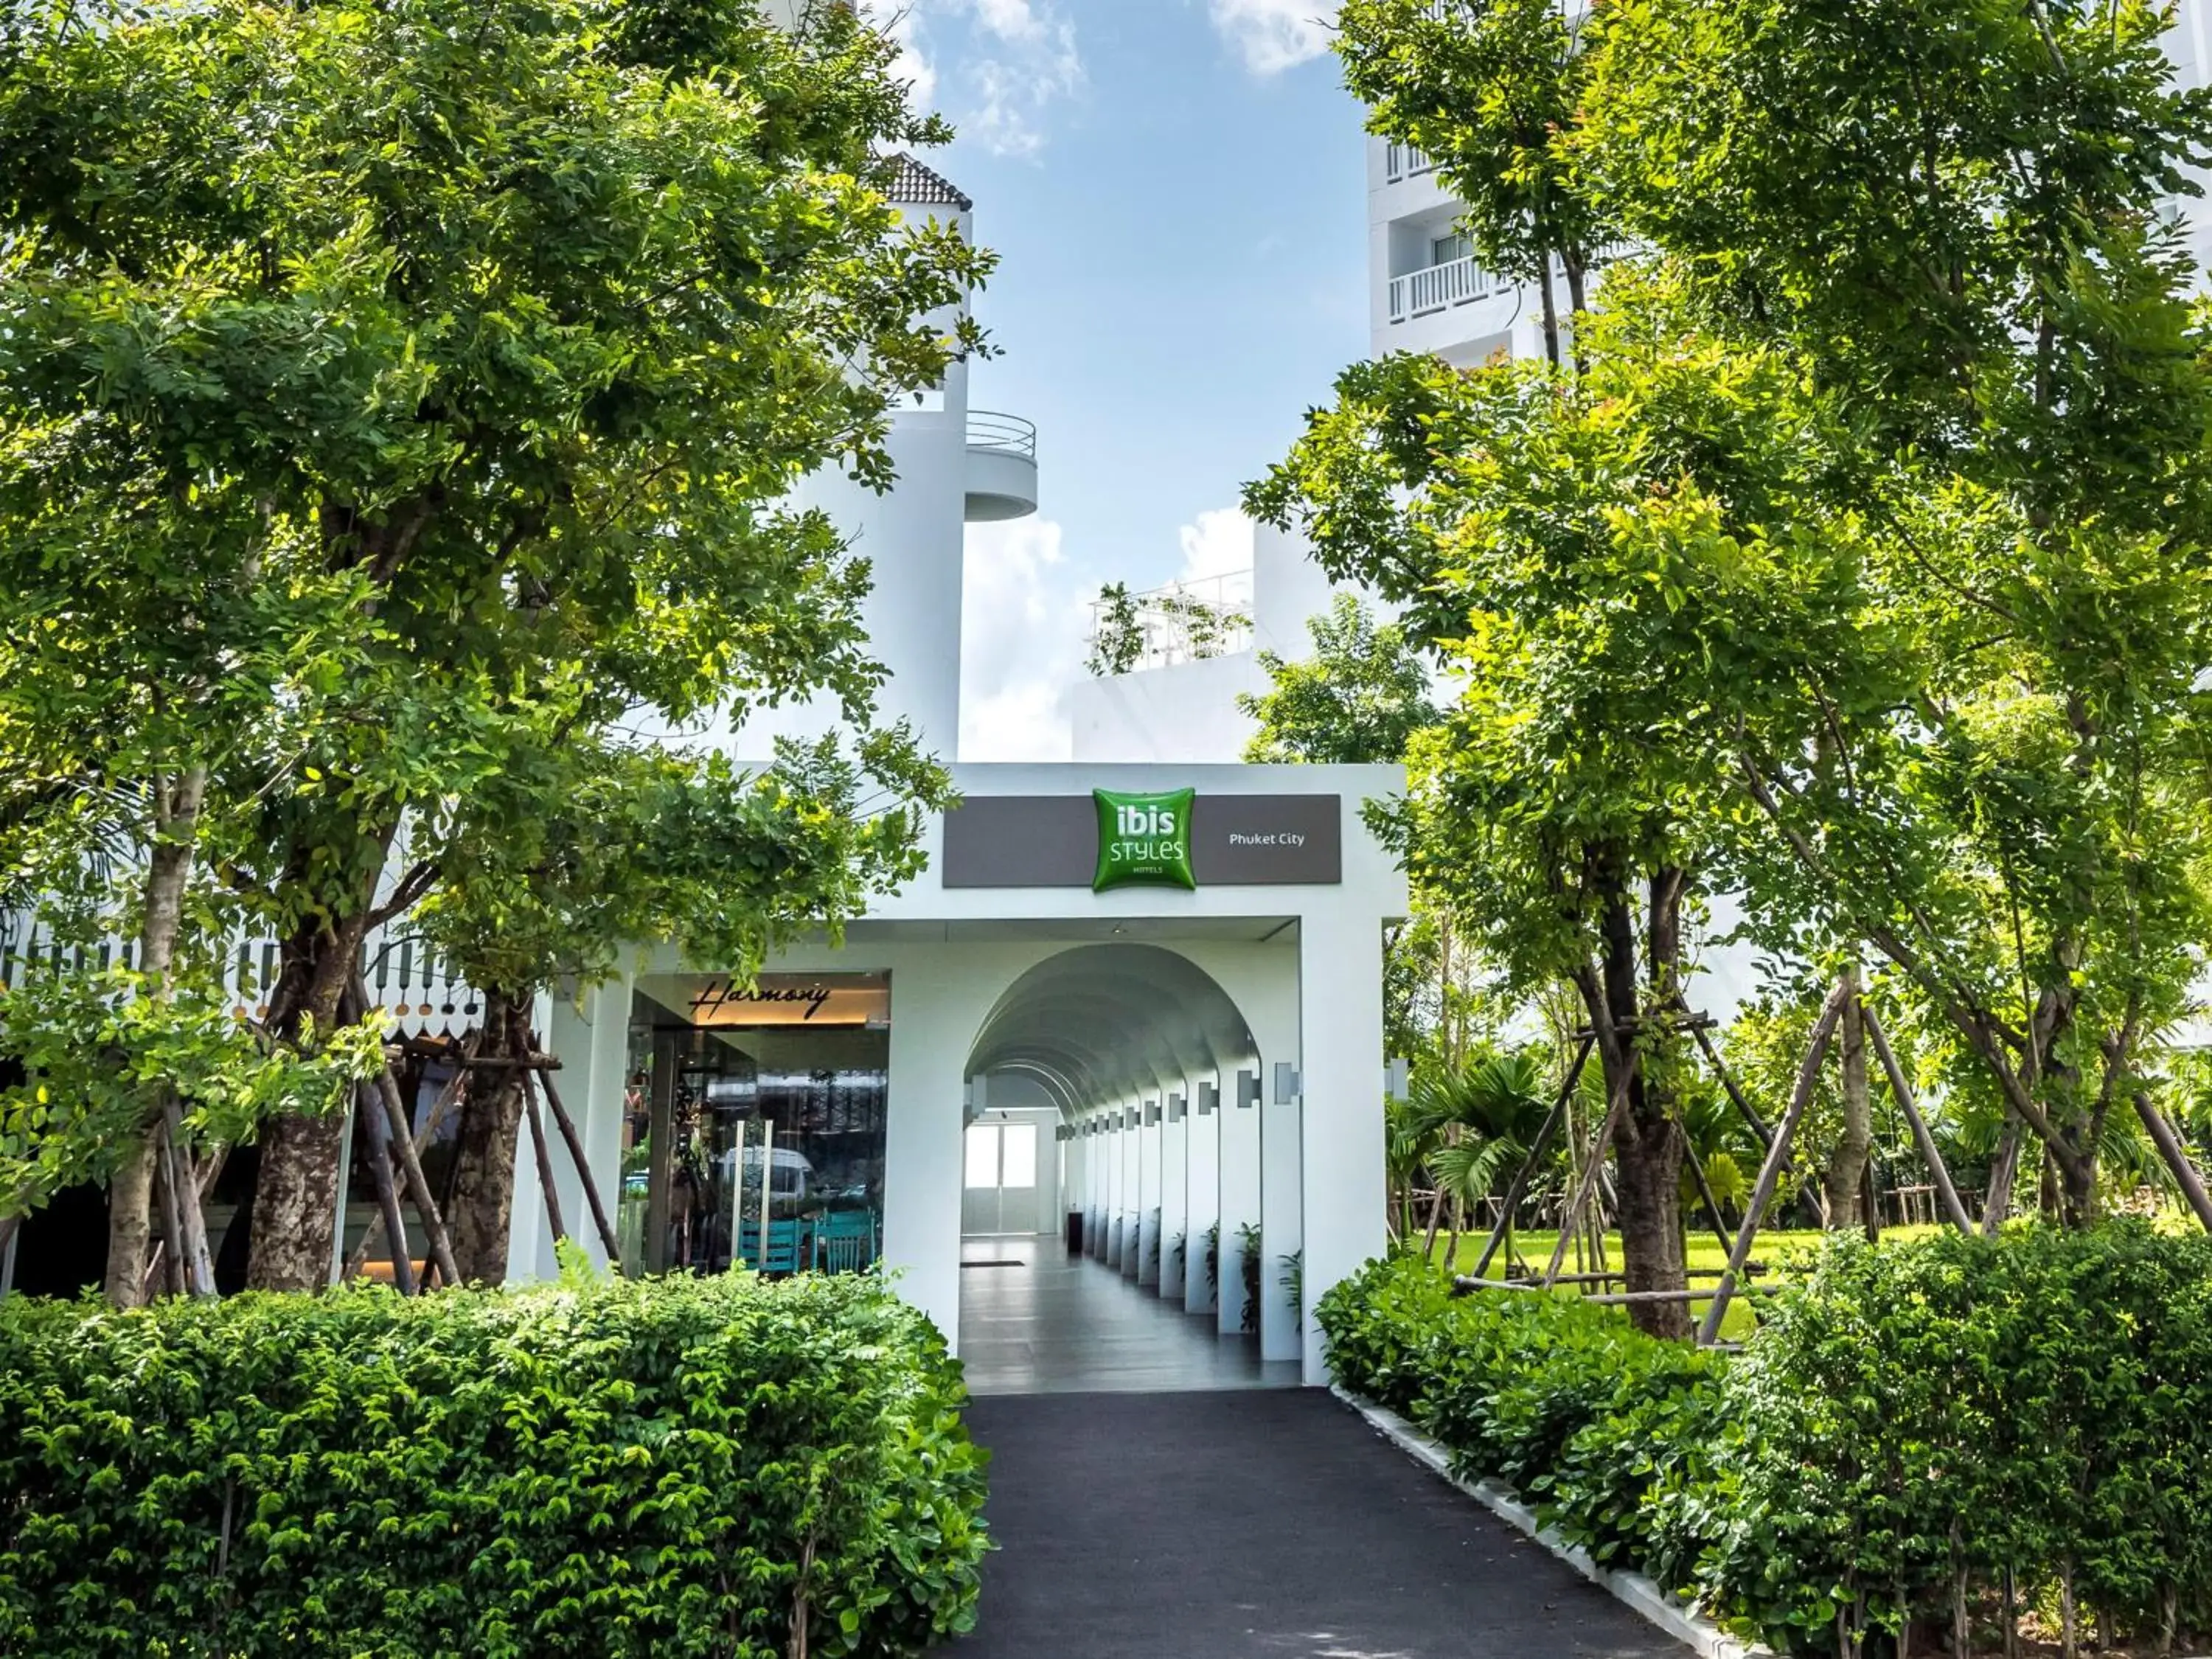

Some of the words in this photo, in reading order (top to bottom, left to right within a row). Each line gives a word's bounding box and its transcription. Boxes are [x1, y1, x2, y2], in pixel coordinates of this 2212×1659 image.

[1117, 804, 1175, 836] ibis
[1229, 833, 1276, 844] Phuket
[1279, 832, 1304, 847] City
